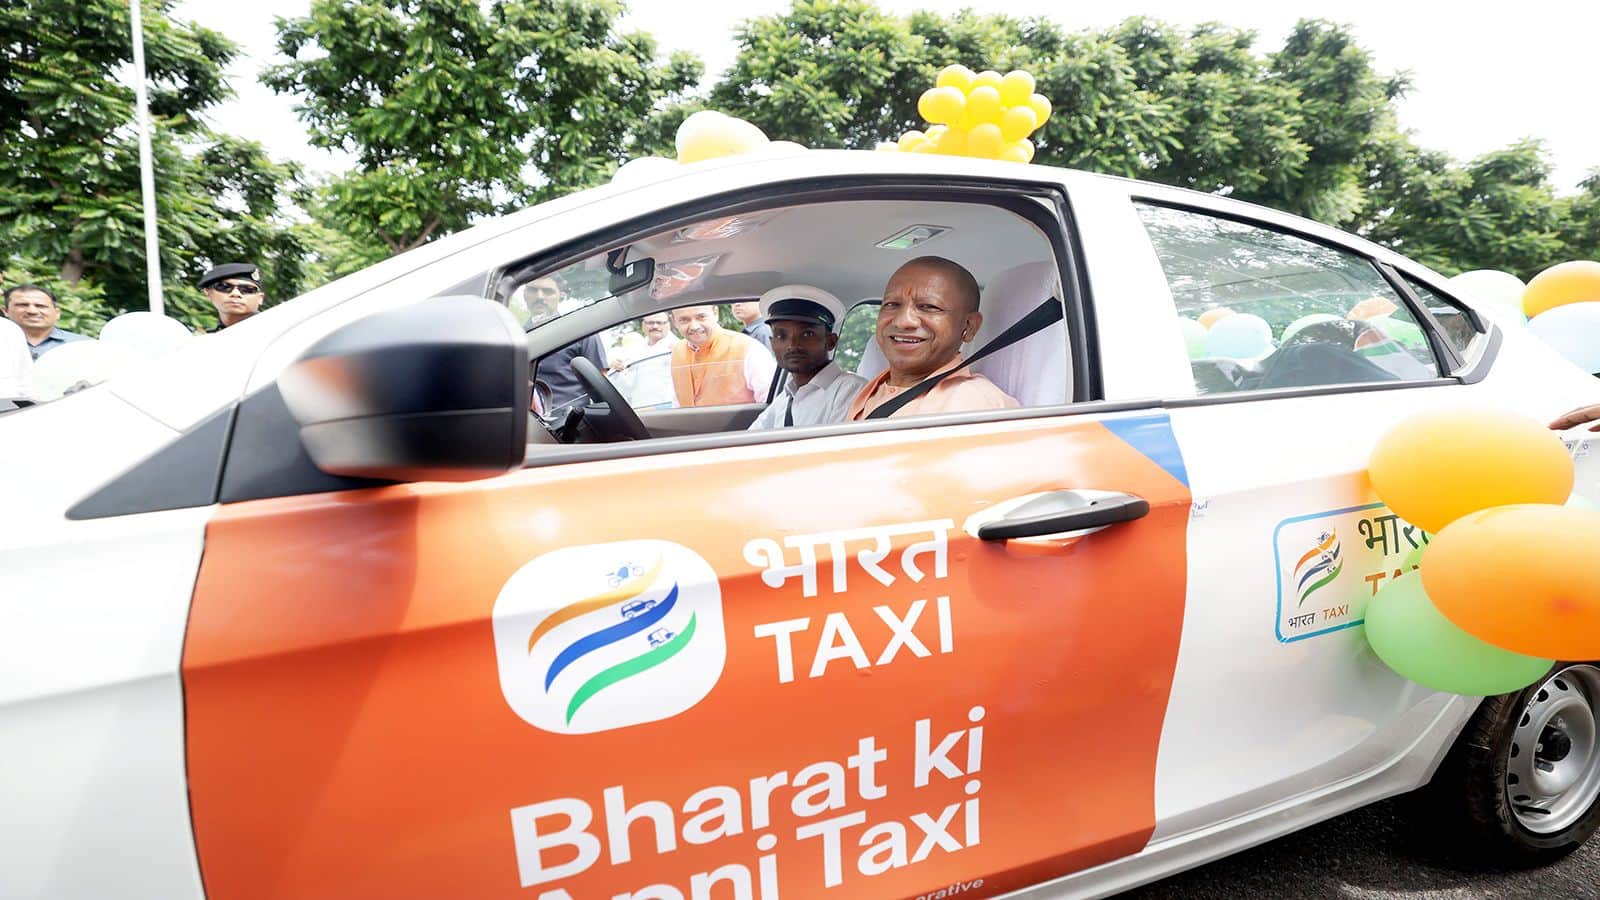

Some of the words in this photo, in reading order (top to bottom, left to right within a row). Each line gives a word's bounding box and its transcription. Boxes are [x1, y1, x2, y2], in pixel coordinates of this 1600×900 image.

[743, 518, 955, 598] भारत
[1358, 514, 1428, 556] भार
[753, 595, 955, 684] TAXI
[1288, 612, 1316, 629] भारत
[1322, 604, 1349, 621] TAXI
[510, 736, 887, 888] Bharat
[914, 705, 986, 788] ki
[796, 780, 982, 889] Taxi
